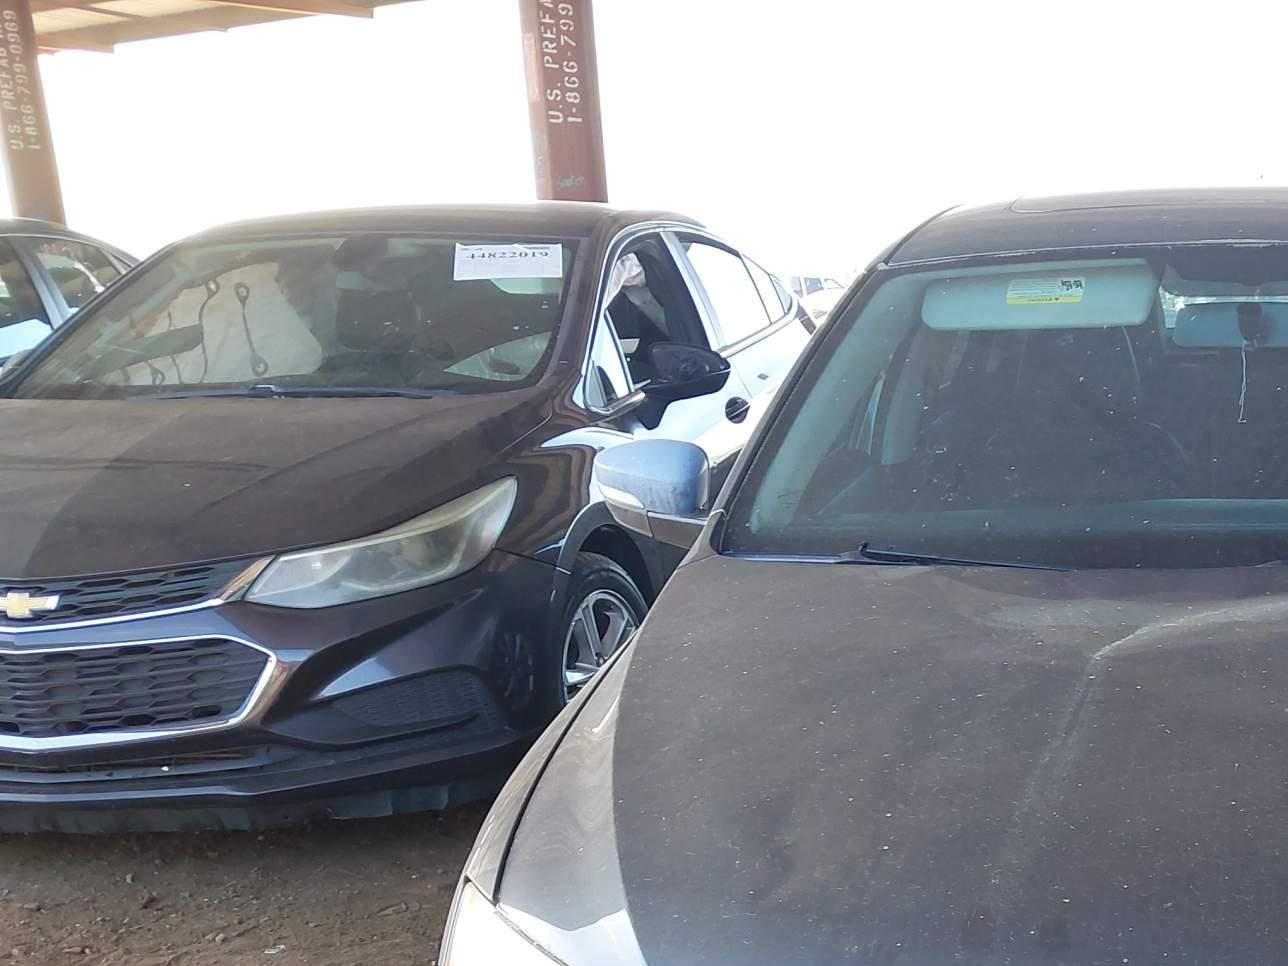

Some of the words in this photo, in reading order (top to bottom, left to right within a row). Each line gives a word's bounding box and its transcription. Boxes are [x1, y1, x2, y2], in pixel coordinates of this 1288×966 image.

[558, 3, 582, 123] 1-866-799
[547, 83, 563, 123] U.S.
[466, 251, 549, 260] 44822019
